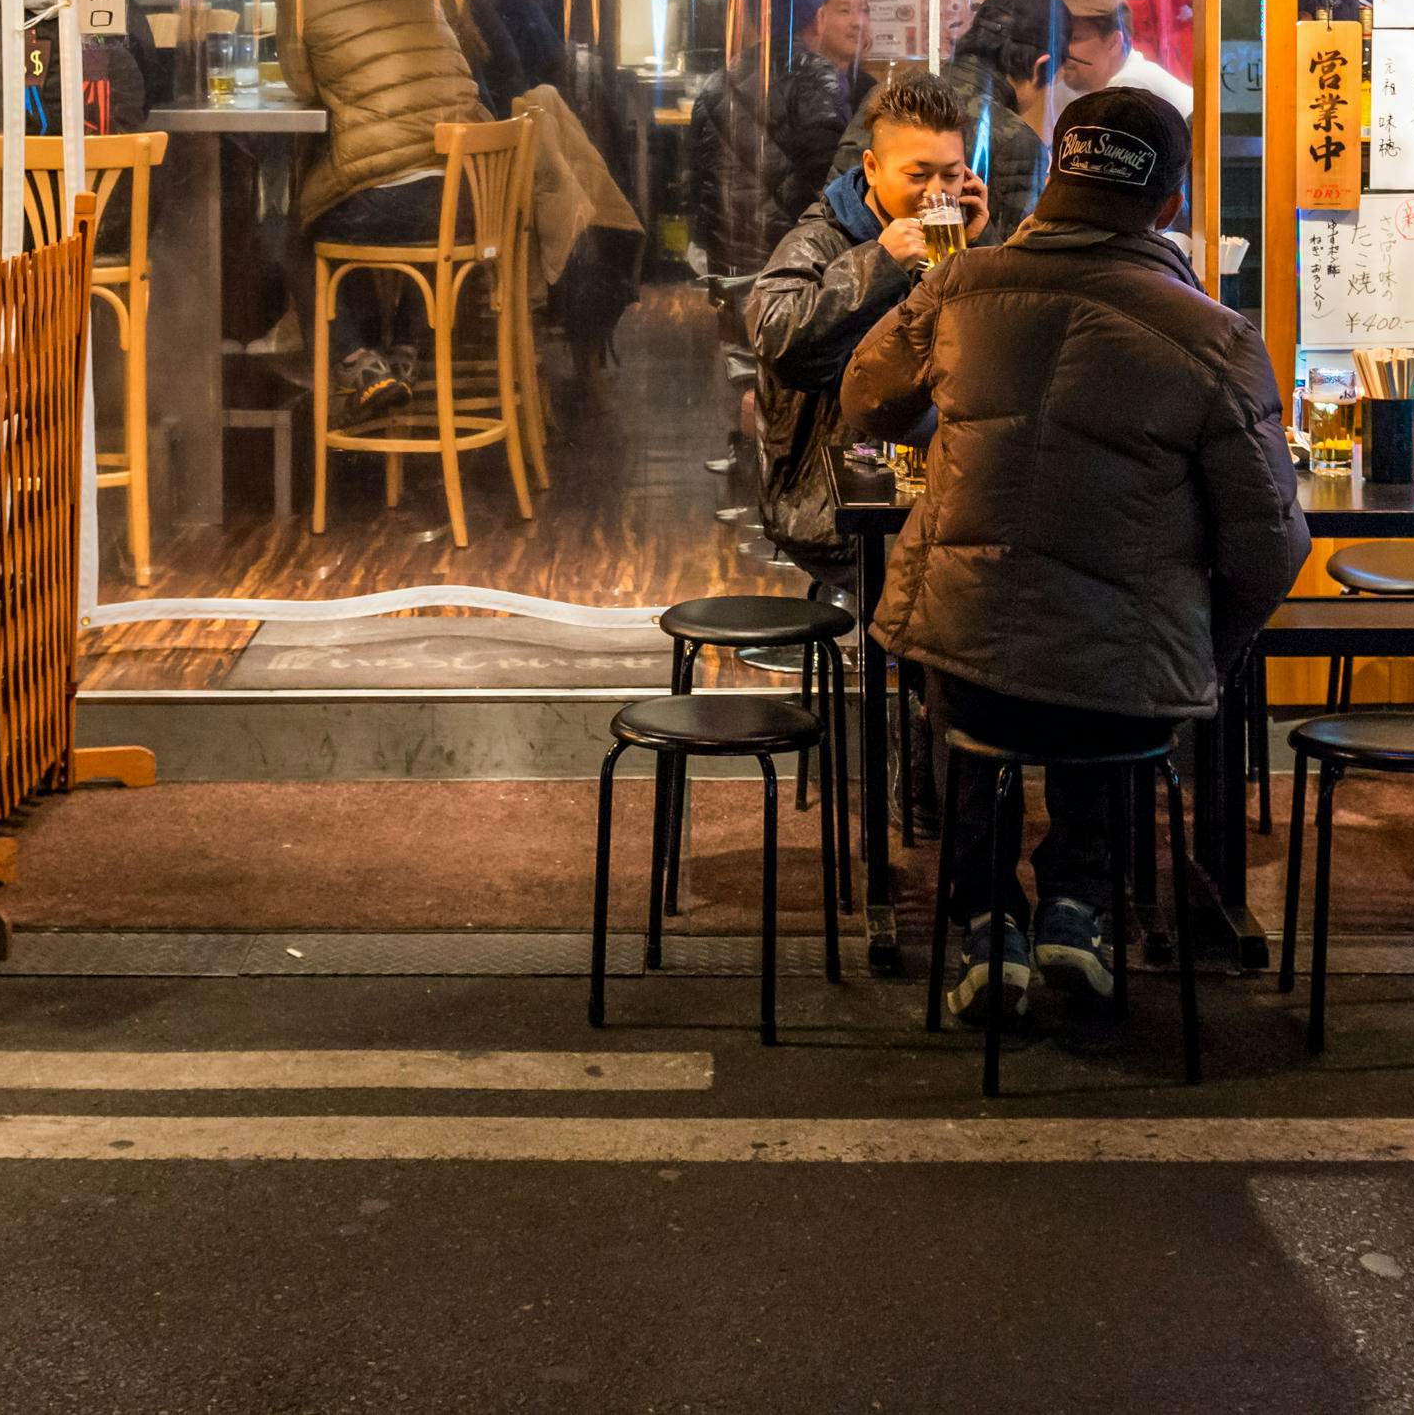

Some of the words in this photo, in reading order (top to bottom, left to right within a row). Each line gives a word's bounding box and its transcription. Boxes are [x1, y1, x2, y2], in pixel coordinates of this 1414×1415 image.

[1309, 50, 1348, 172] 営業中
[1348, 224, 1376, 296] たこ焼
